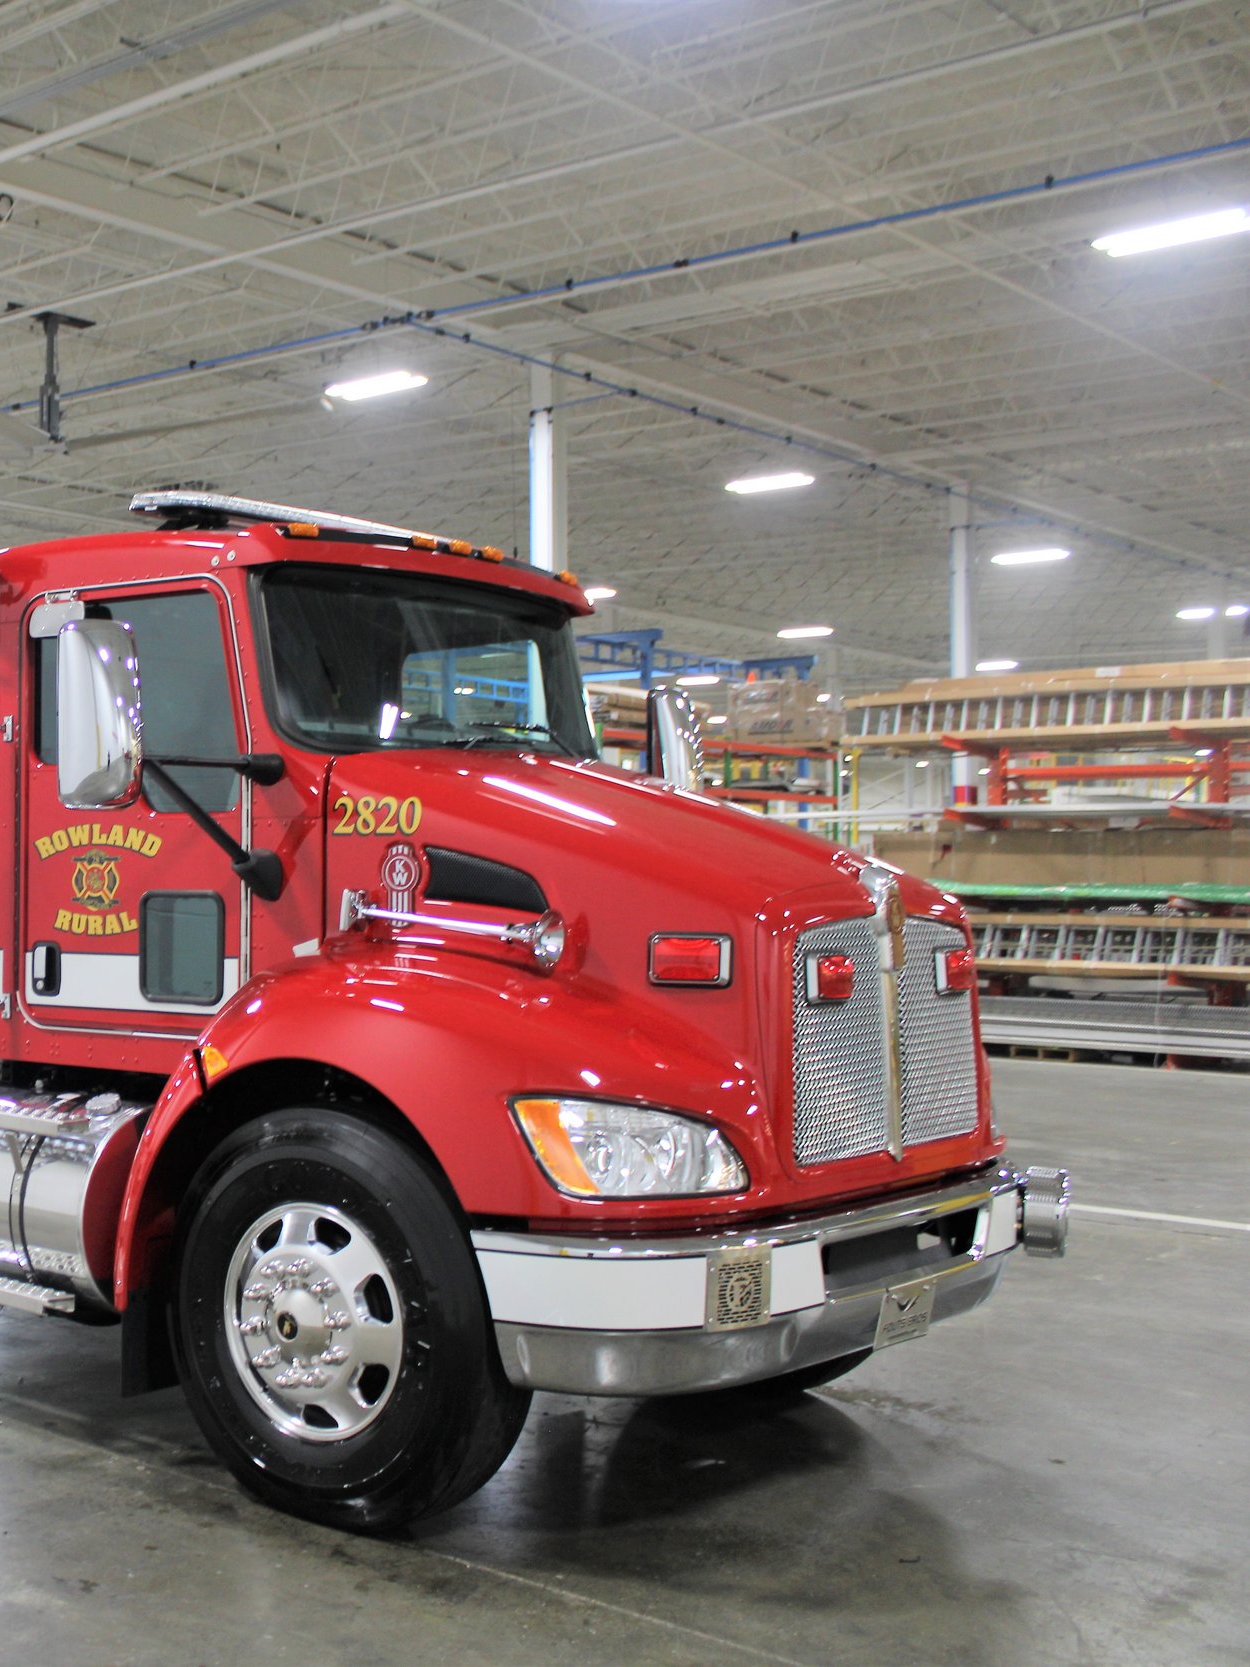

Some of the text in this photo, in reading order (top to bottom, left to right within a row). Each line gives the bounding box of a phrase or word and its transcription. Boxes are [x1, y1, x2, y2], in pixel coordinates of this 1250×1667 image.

[332, 795, 423, 836] 2820
[33, 822, 164, 861] ROWLAND
[53, 907, 139, 937] RURAL
